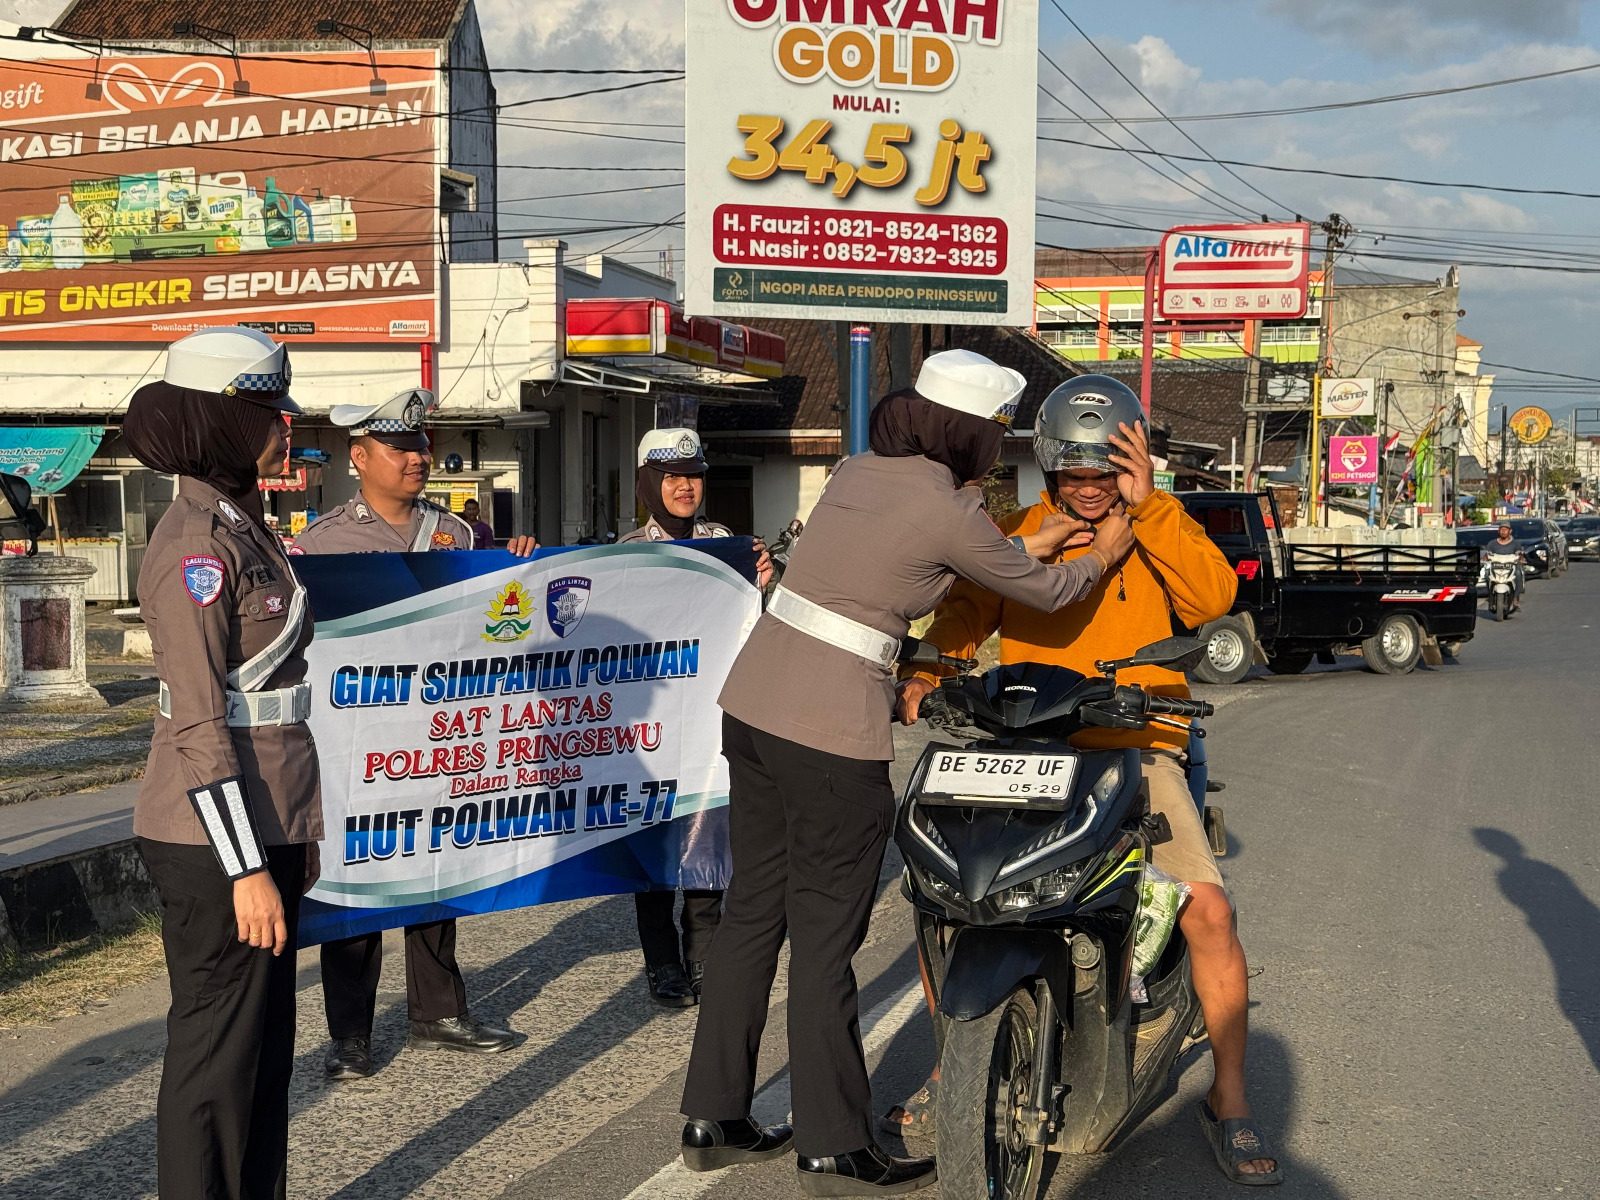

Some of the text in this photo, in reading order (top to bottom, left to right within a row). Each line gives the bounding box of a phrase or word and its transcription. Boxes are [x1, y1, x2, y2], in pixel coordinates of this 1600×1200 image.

[777, 27, 955, 87] GOLD
[98, 115, 263, 154] BELANJA
[279, 99, 424, 137] HARIAN
[726, 115, 992, 206] 34,5 jt
[209, 201, 235, 215] mama
[266, 208, 279, 218] KIT
[722, 214, 746, 232] H.
[750, 214, 810, 235] Fauzi
[824, 217, 998, 244] 0821-8524-1362
[722, 238, 746, 256] H.
[749, 239, 809, 259] Nasir
[823, 242, 998, 267] 0852-7932-3925
[1174, 236, 1297, 258] Alfamart
[59, 278, 192, 313] ONGKIR
[203, 261, 421, 301] SEPUASNYA
[760, 281, 998, 303] NGOPI AREA PENDOPO PRINGSEWU
[151, 323, 192, 332] Download
[392, 322, 427, 331] Alfamart
[1326, 390, 1369, 404] MASTER
[185, 557, 223, 569] LALU LINTAS
[551, 579, 588, 589] LALU LINTAS
[330, 638, 700, 708] GIAT SIMPATIK POLWAN
[1004, 685, 1037, 693] HONDA
[429, 691, 612, 740] SAT LANTAS
[363, 722, 663, 782] POLRES PRINGSEWU
[449, 760, 583, 798] Dalam Rangka
[937, 756, 1065, 777] BE 5262 UF
[343, 778, 678, 865] HUT POLWAN KE-77
